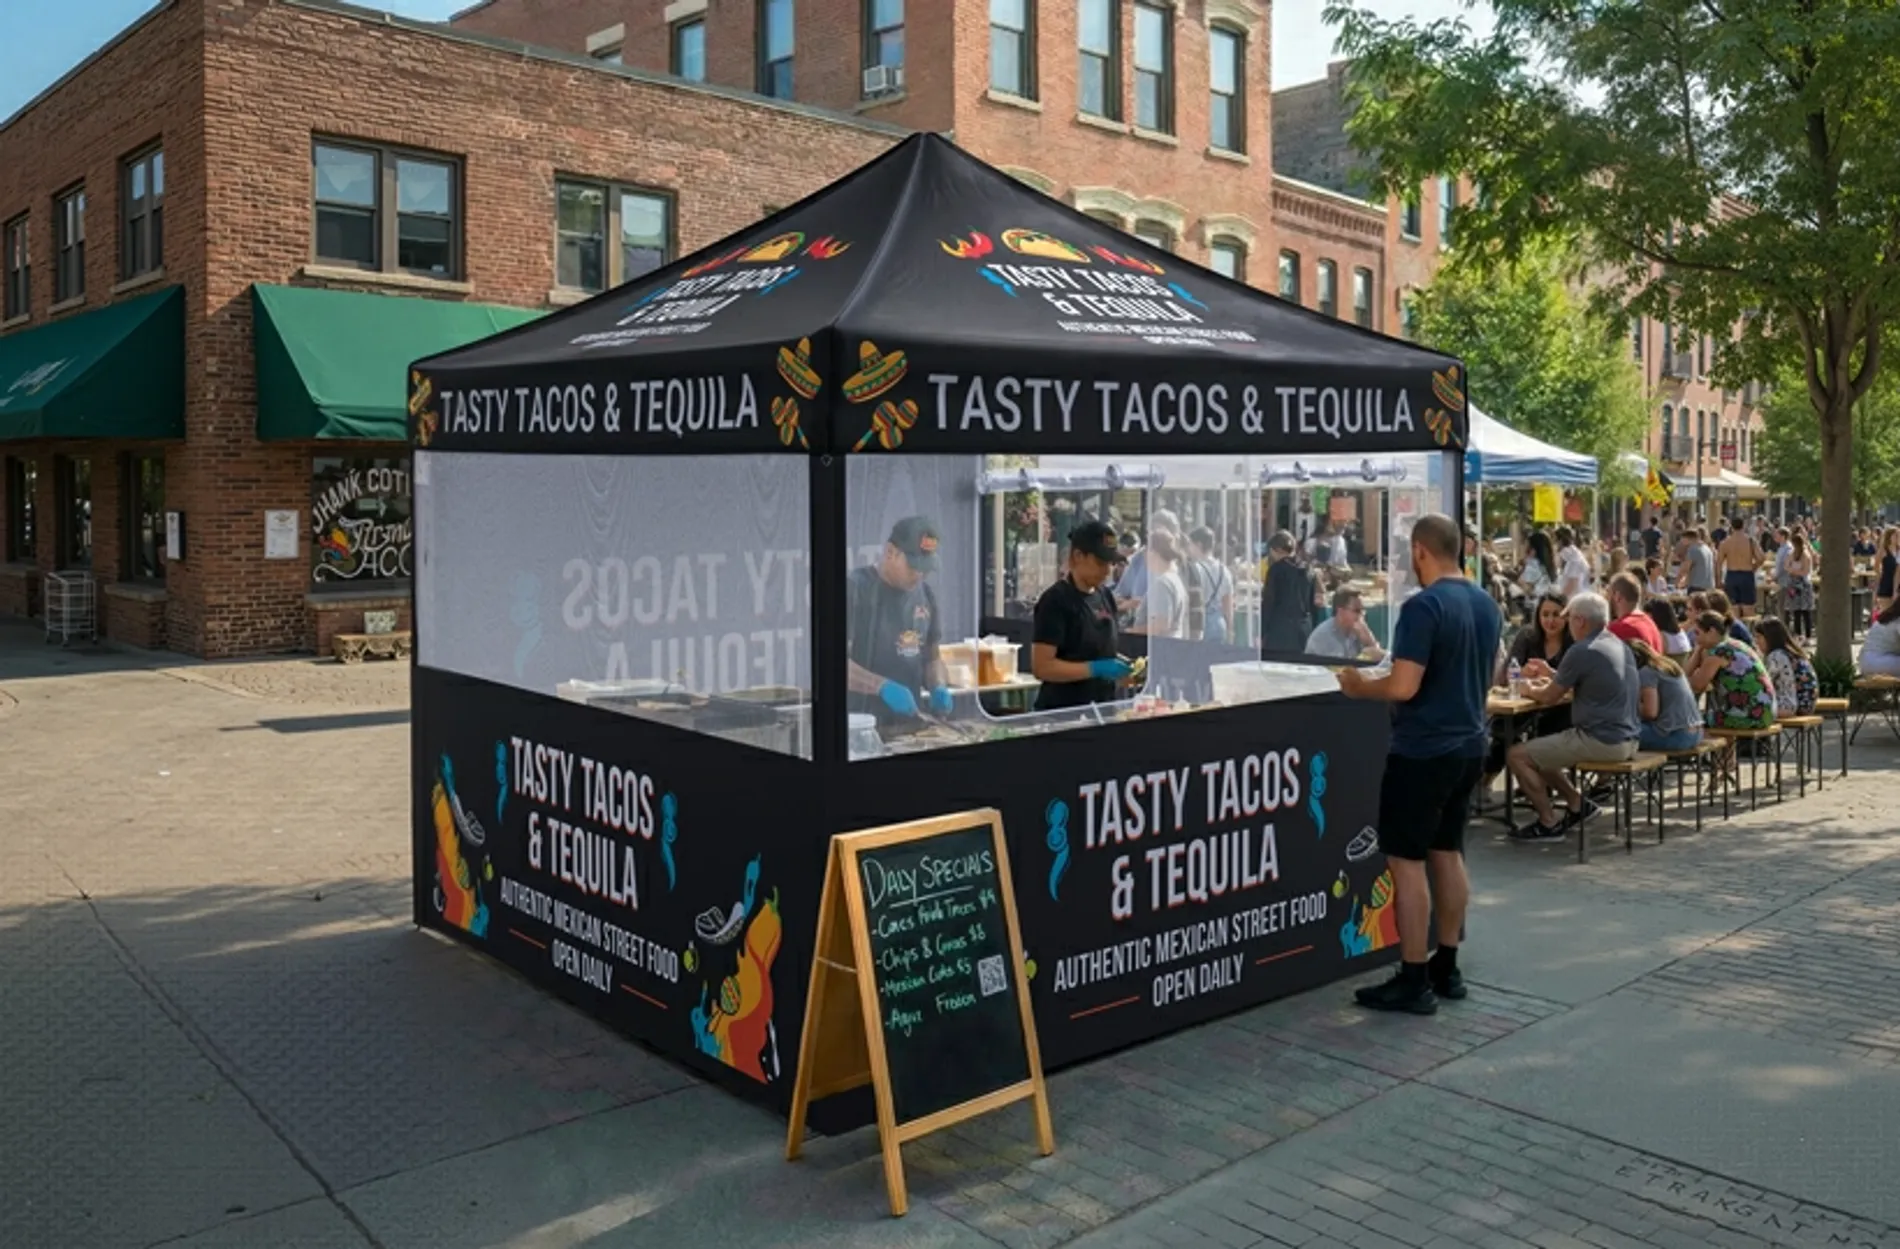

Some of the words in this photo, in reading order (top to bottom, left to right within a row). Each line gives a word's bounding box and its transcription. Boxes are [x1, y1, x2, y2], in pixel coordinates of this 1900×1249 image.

[987, 263, 1082, 290] TASTY
[1073, 269, 1174, 298] TACOS
[1042, 292, 1082, 316] &
[1067, 294, 1204, 324] TEQUILA
[440, 389, 509, 433] TASTY
[515, 384, 596, 433] TACOS
[603, 382, 620, 433] &
[630, 373, 759, 438] TEQUILA
[928, 373, 1081, 433] TASTY
[1094, 381, 1229, 434] TACOS
[1241, 384, 1264, 434] &
[1275, 386, 1415, 439] TEQUILA
[511, 736, 574, 811] TASTY
[580, 756, 655, 840] TACOS
[1079, 766, 1190, 849] TASTY
[1202, 747, 1300, 824] TACOS
[528, 812, 543, 870] &
[547, 817, 639, 912] TEQUILA
[1112, 855, 1135, 920] &
[1146, 823, 1280, 912] TEQUILA
[501, 876, 552, 925] AUTHENTIC
[554, 898, 602, 948] MEXICAN
[603, 921, 645, 968] STREET
[647, 943, 679, 983] FOOD
[552, 938, 580, 978] OPEN
[582, 953, 613, 993] DAILY
[1054, 937, 1151, 993] AUTHENTIC
[1156, 915, 1229, 964] MEXICAN
[1232, 901, 1287, 943] STREET
[1291, 891, 1328, 927] FOOD
[1153, 965, 1195, 1007] OPEN
[1200, 953, 1244, 994] DAILY
